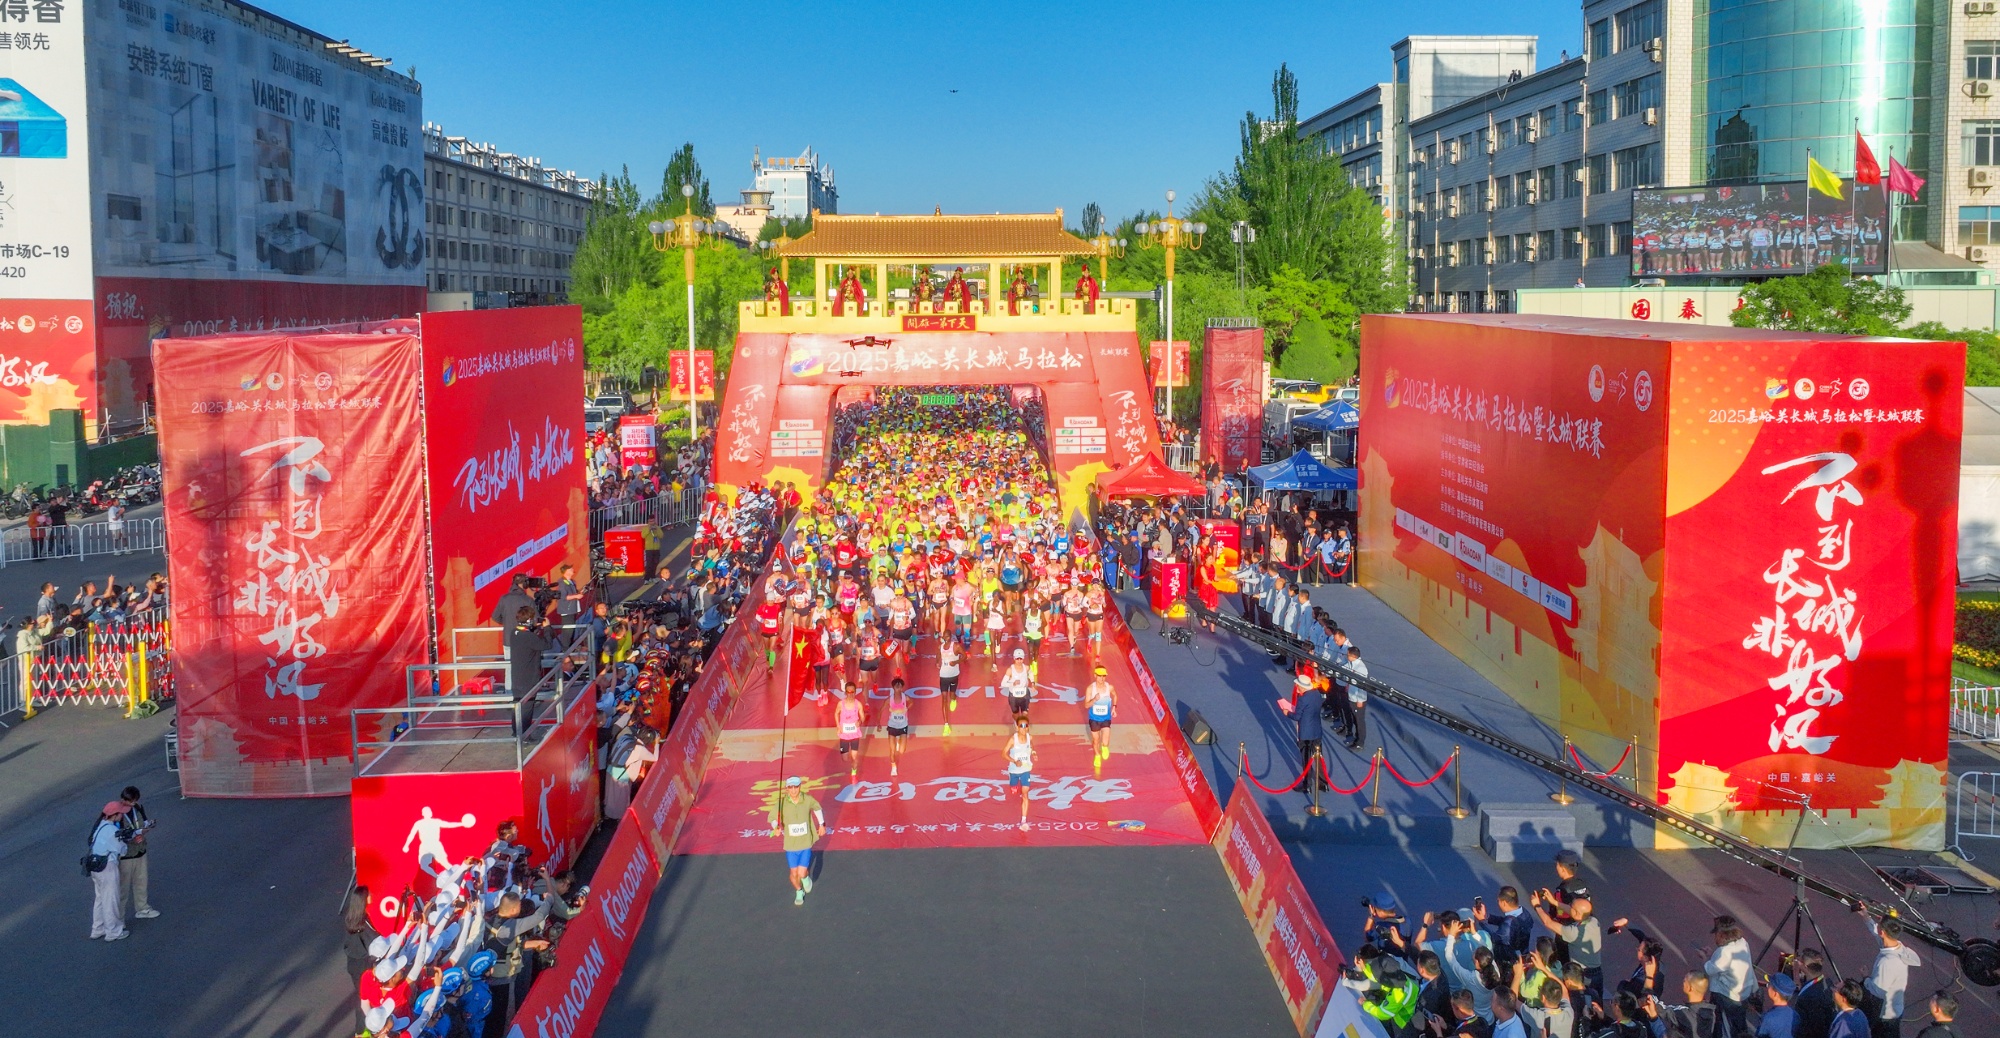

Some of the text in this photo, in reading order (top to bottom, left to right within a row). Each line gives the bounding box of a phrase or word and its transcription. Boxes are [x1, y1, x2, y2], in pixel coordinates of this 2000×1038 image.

[127, 41, 214, 92] 安静系统门窗
[251, 79, 341, 131] VARIETY OF LIFE
[826, 346, 1084, 373] 2025嘉峪关长城马拉松
[191, 396, 383, 414] 2025嘉峪关长城马拉松暨长城联赛
[1402, 377, 1605, 459] 2025嘉峪关长城马拉松暨长城联赛
[1708, 407, 1925, 425] 2025嘉峪关长城马拉松暨长城联赛
[612, 841, 649, 924] QIAODAN
[1274, 904, 1317, 995] 嘉峪关市人民政府
[552, 938, 606, 1038] QIAODAN
